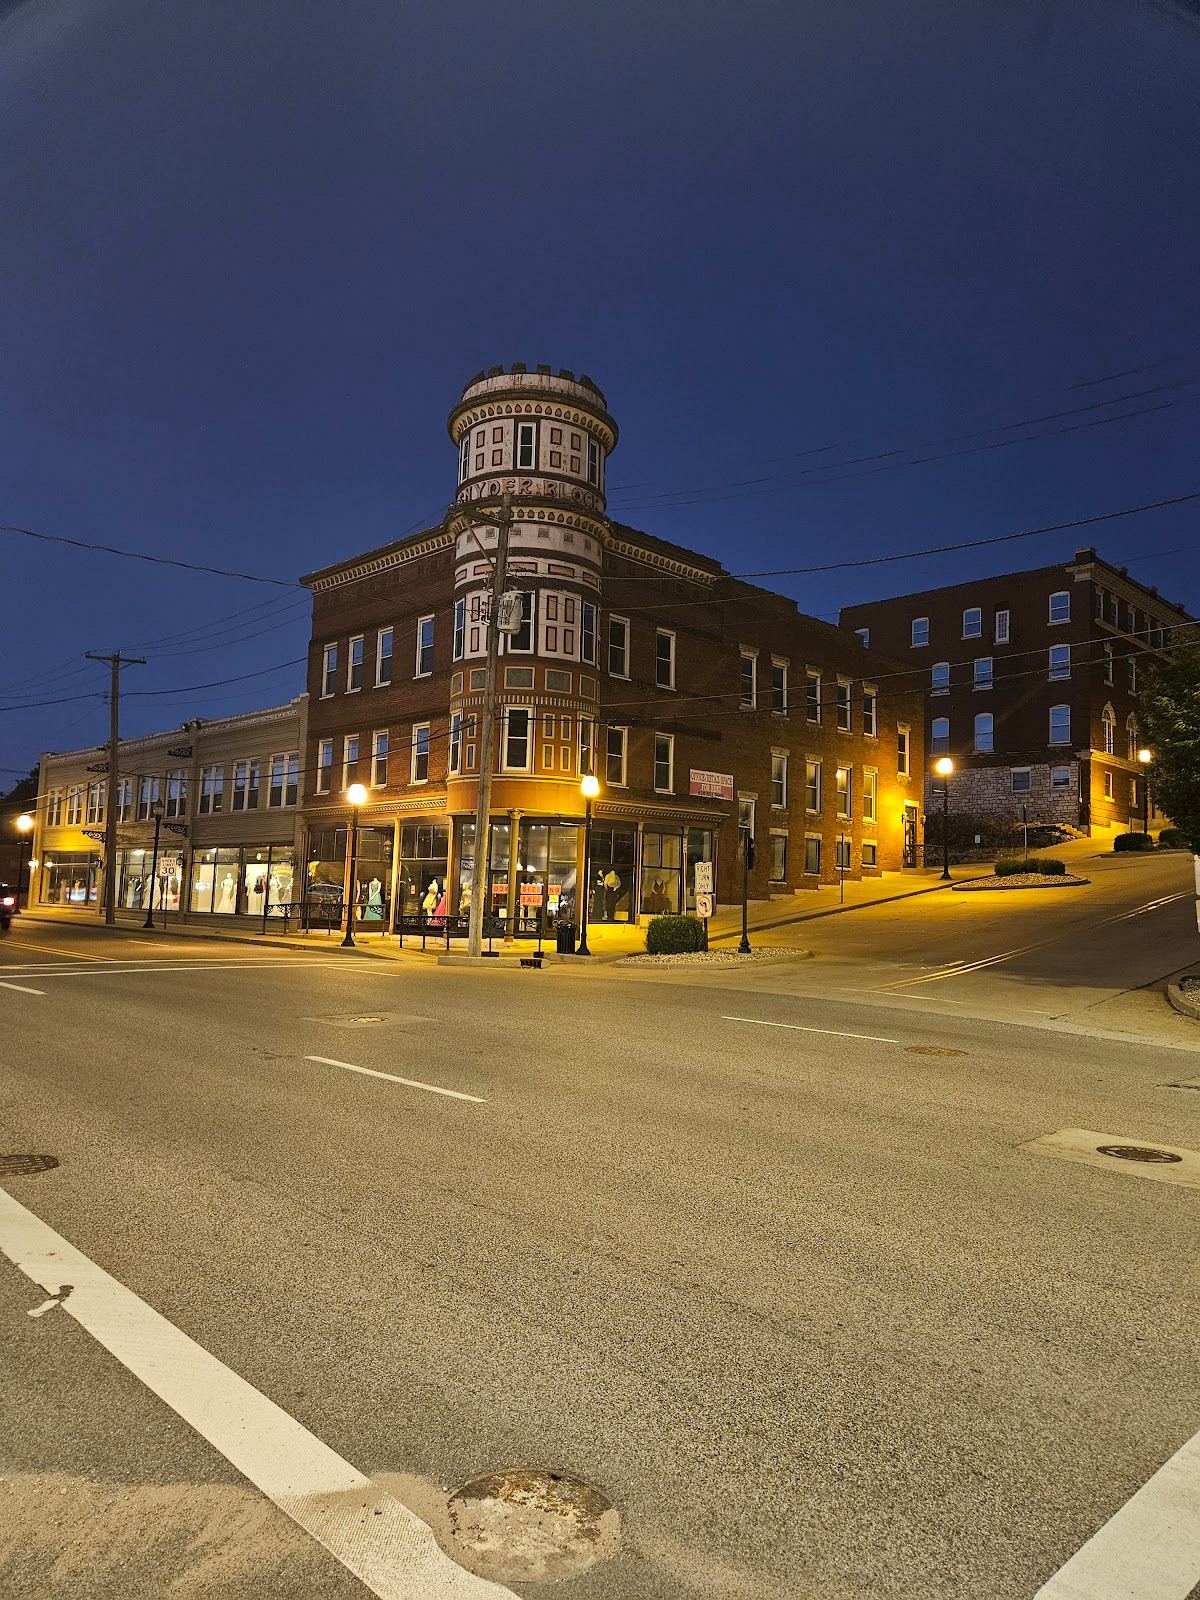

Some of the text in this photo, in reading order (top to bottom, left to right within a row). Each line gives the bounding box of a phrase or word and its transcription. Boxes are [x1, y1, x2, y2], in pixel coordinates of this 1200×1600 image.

[701, 783, 711, 792] FOR
[696, 865, 710, 873] RIGHT
[698, 882, 709, 890] ONLY
